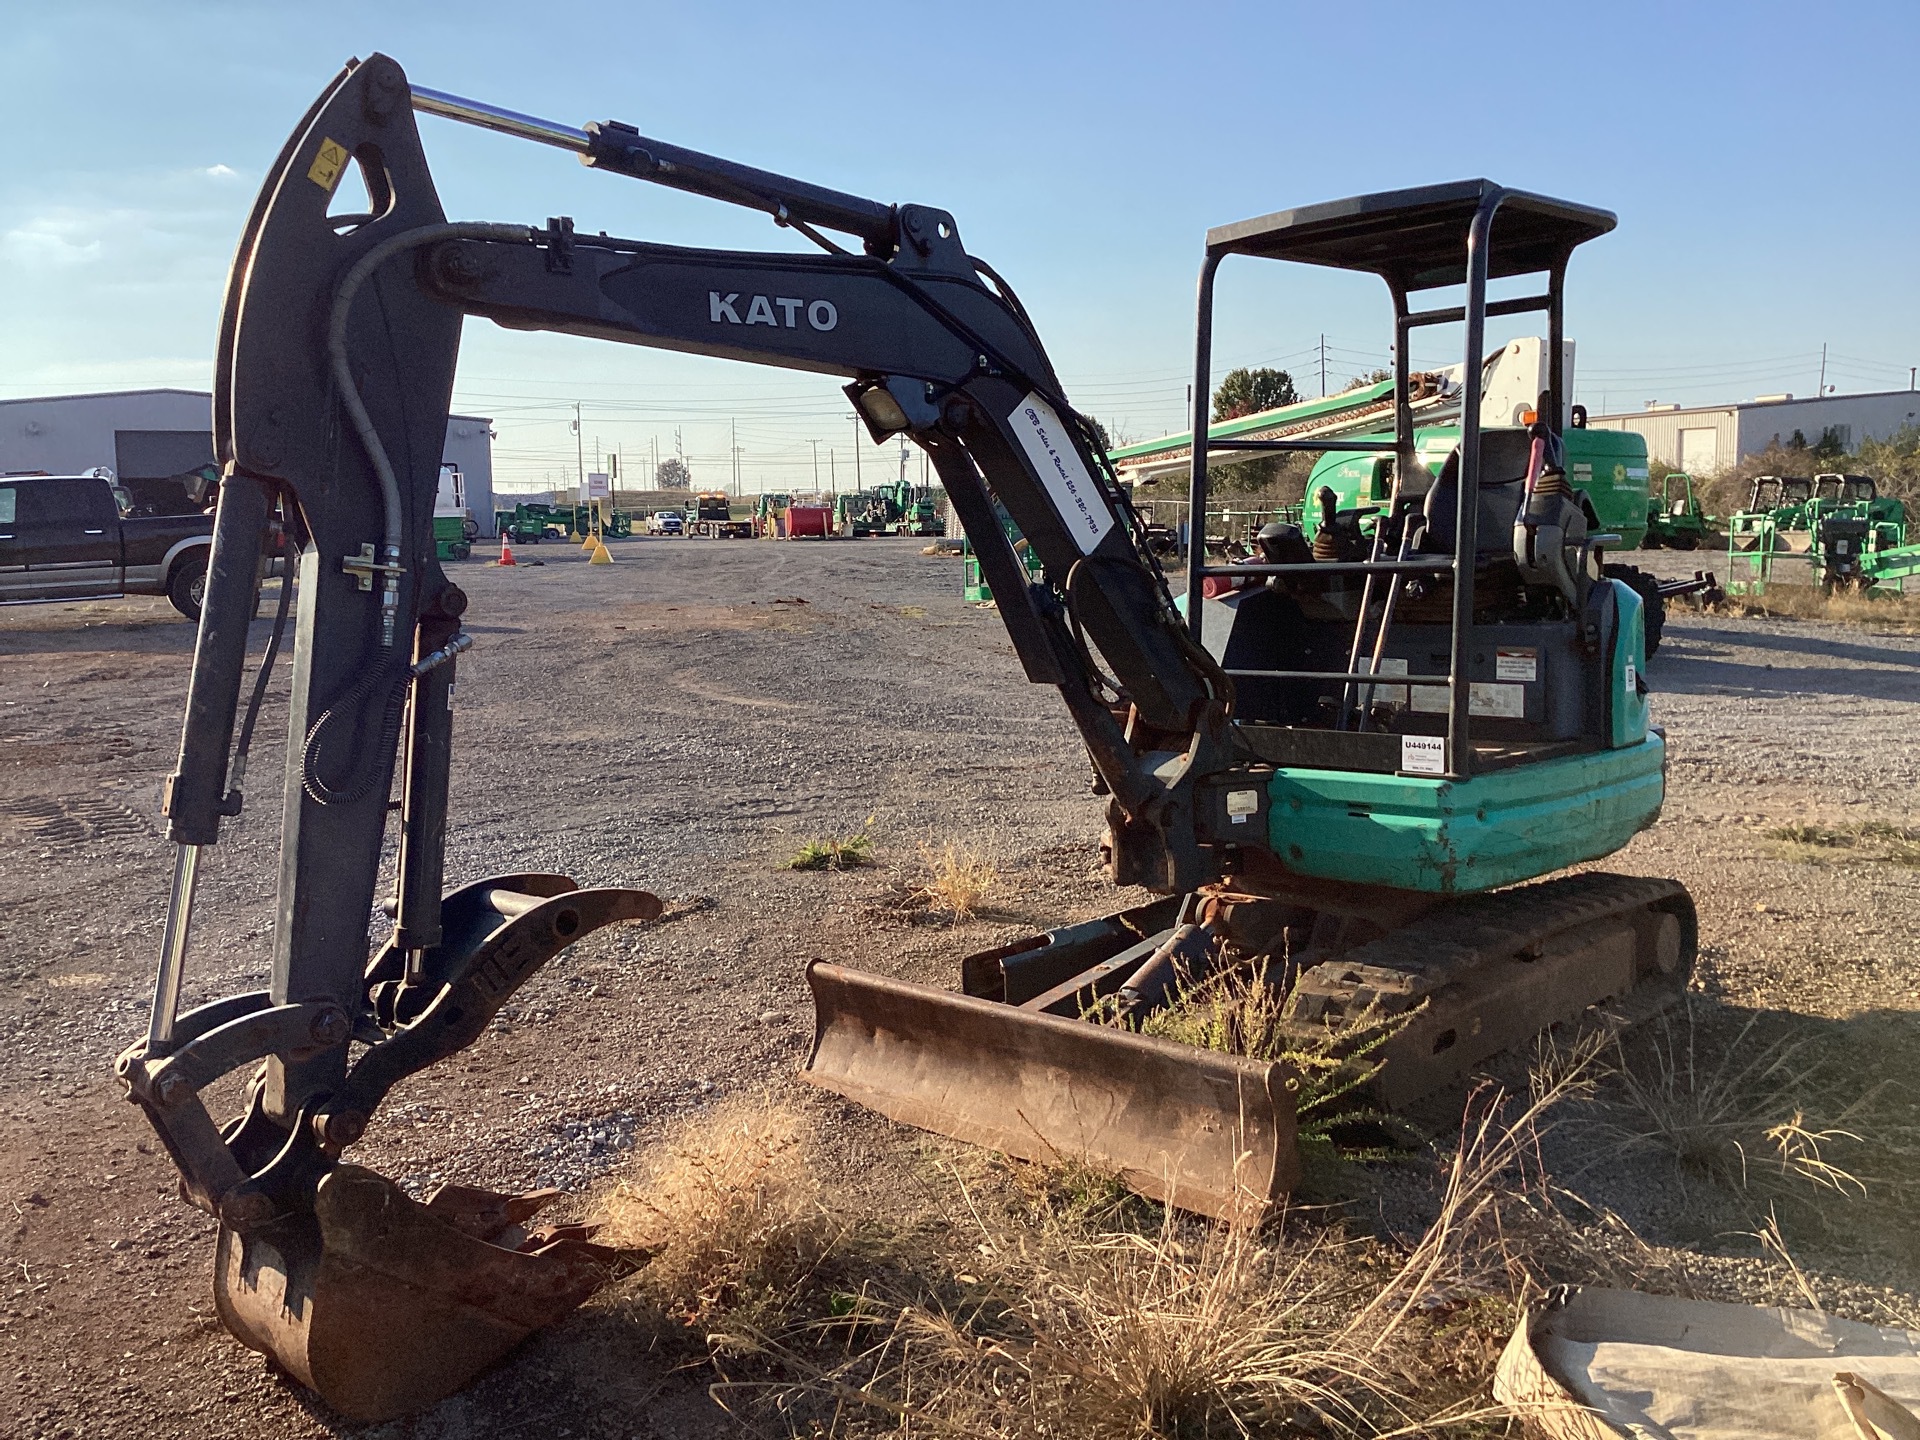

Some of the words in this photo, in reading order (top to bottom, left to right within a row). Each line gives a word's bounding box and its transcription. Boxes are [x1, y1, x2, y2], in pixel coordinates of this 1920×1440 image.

[709, 291, 838, 331] KATO
[1036, 428, 1050, 448] Sales
[1053, 456, 1069, 480] Rental
[1066, 480, 1099, 534] 256-320-7935
[1405, 741, 1442, 751] U449144
